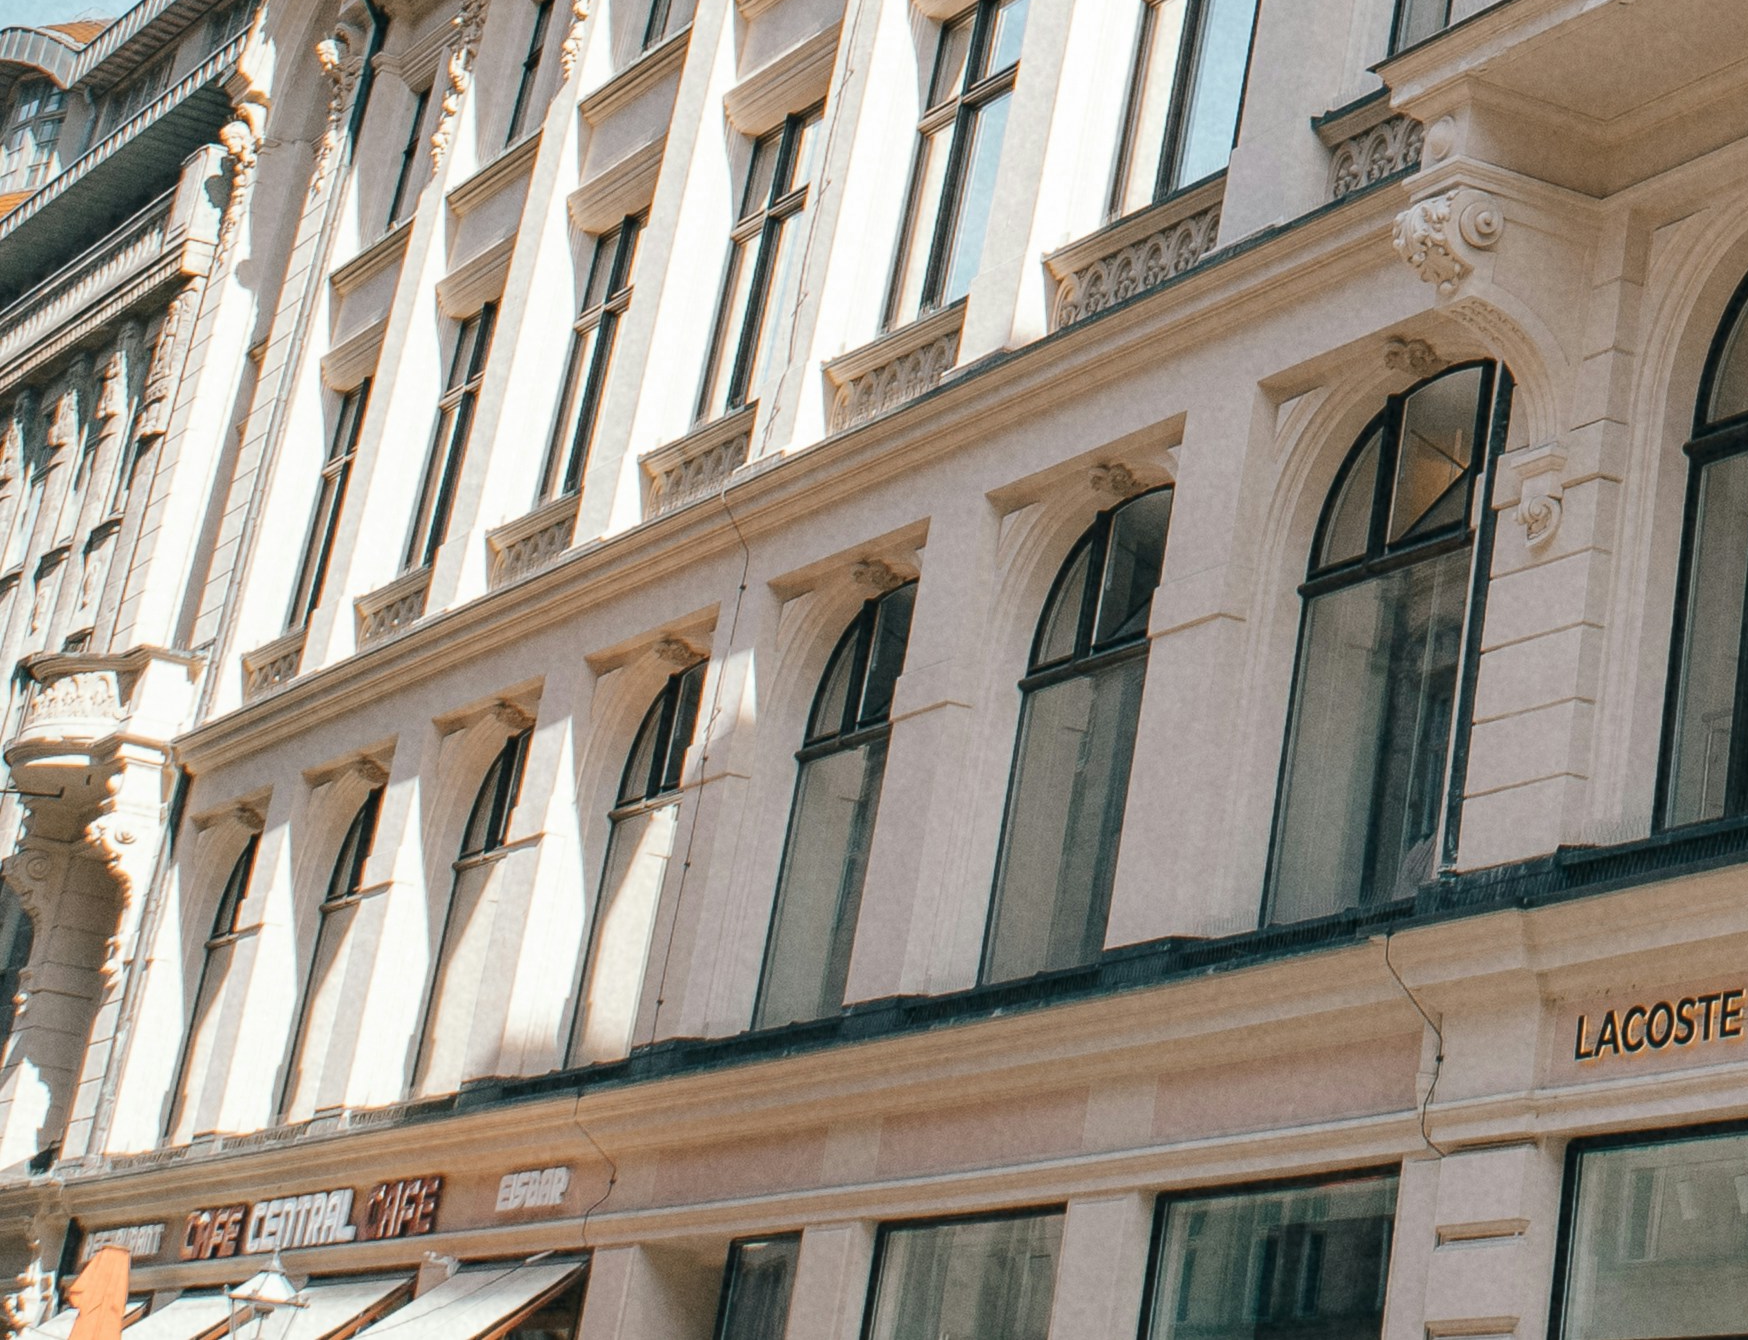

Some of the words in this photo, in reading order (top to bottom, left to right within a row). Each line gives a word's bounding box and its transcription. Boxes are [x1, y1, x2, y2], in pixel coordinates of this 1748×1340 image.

[1574, 988, 1746, 1061] LACOSTE
[244, 1188, 358, 1254] CENTRAL
[495, 1166, 571, 1213] EISBAR
